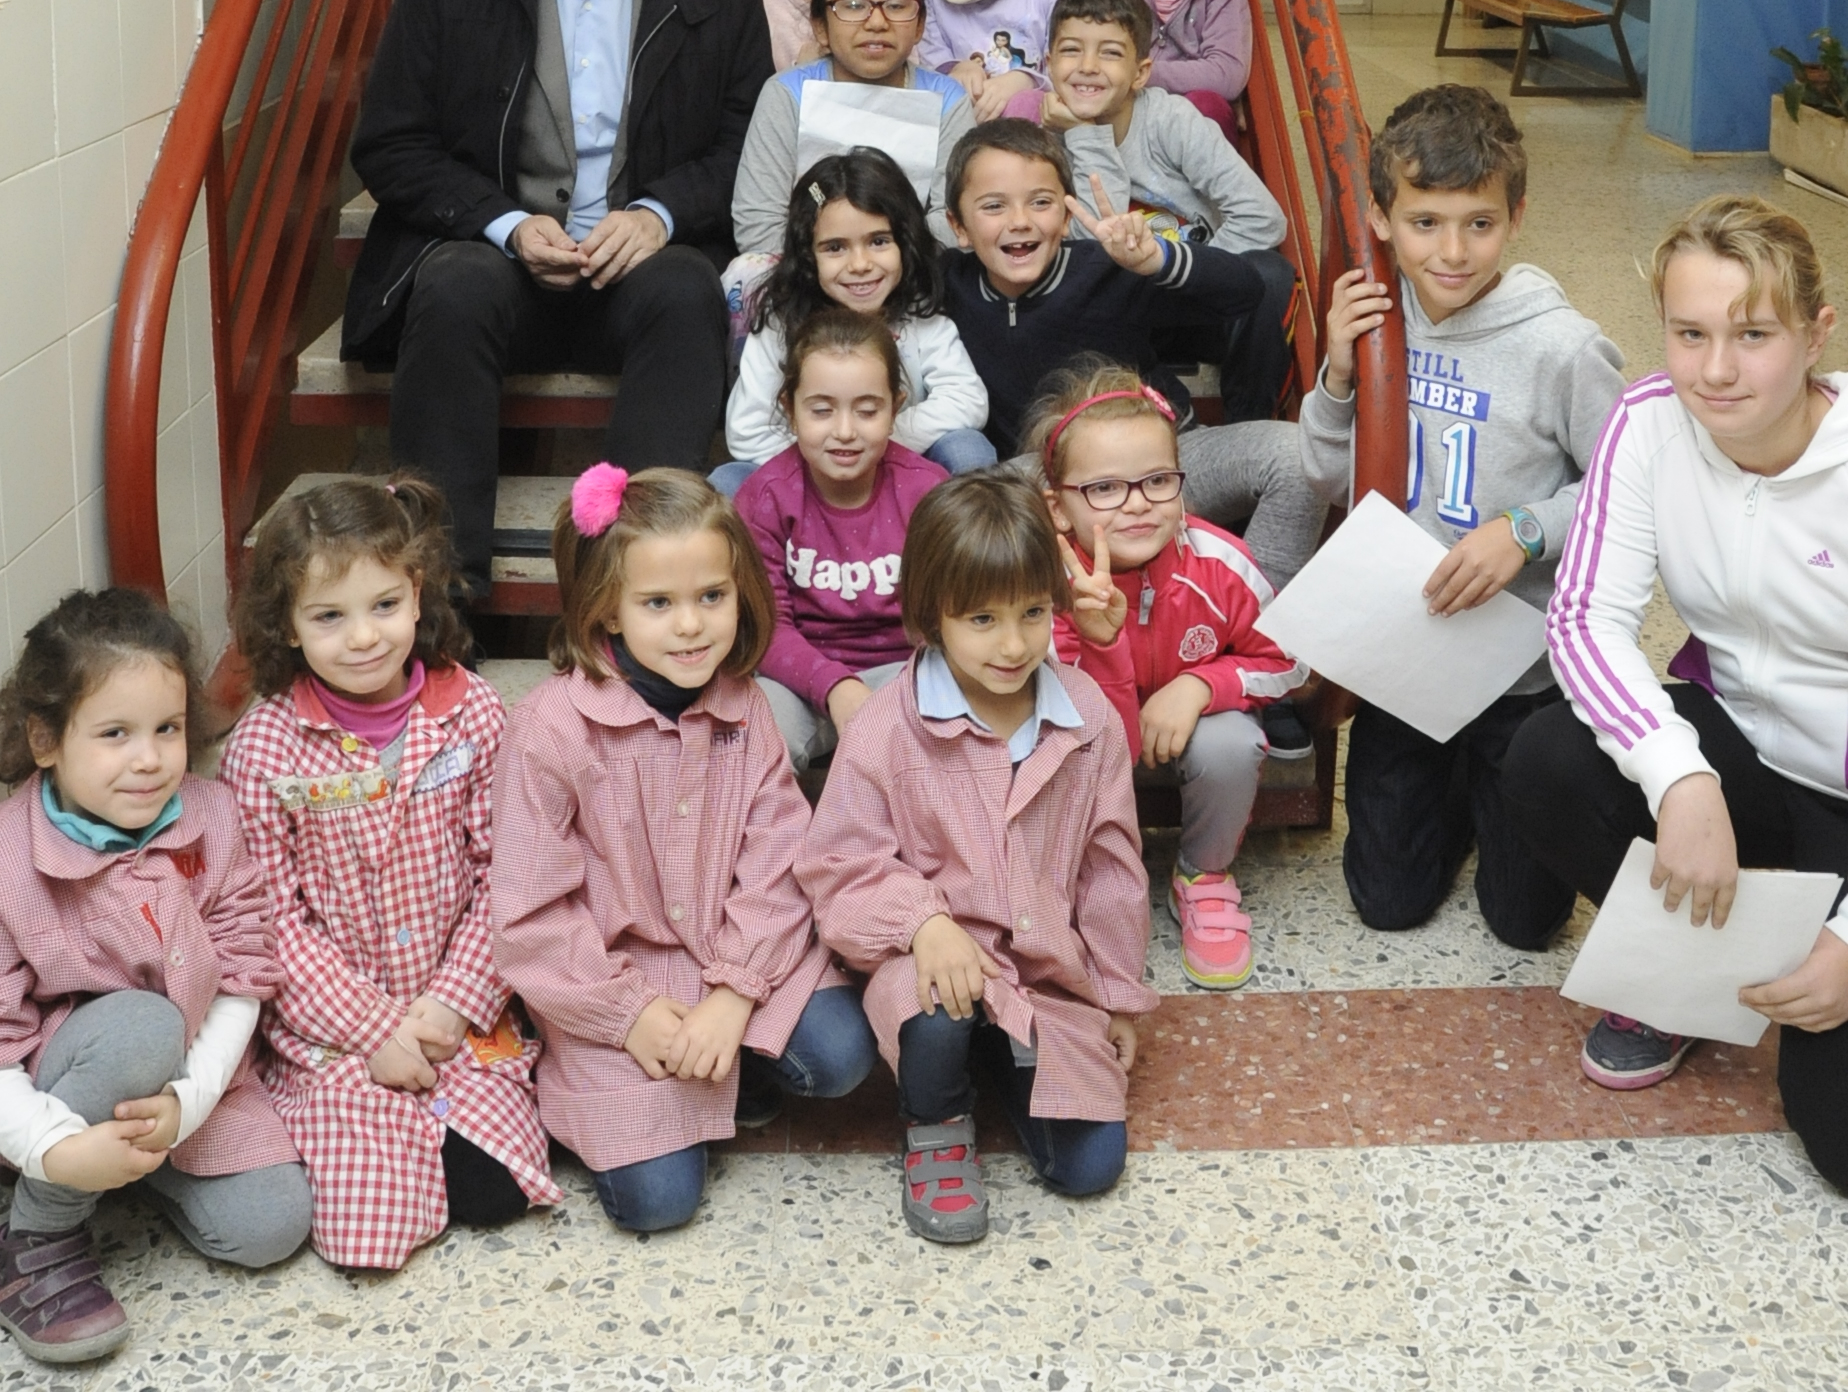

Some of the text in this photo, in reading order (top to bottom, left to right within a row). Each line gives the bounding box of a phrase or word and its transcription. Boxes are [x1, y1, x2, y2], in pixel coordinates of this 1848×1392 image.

[1410, 377, 1478, 417] MBER
[786, 538, 902, 601] Happ
[1807, 558, 1835, 569] adidas
